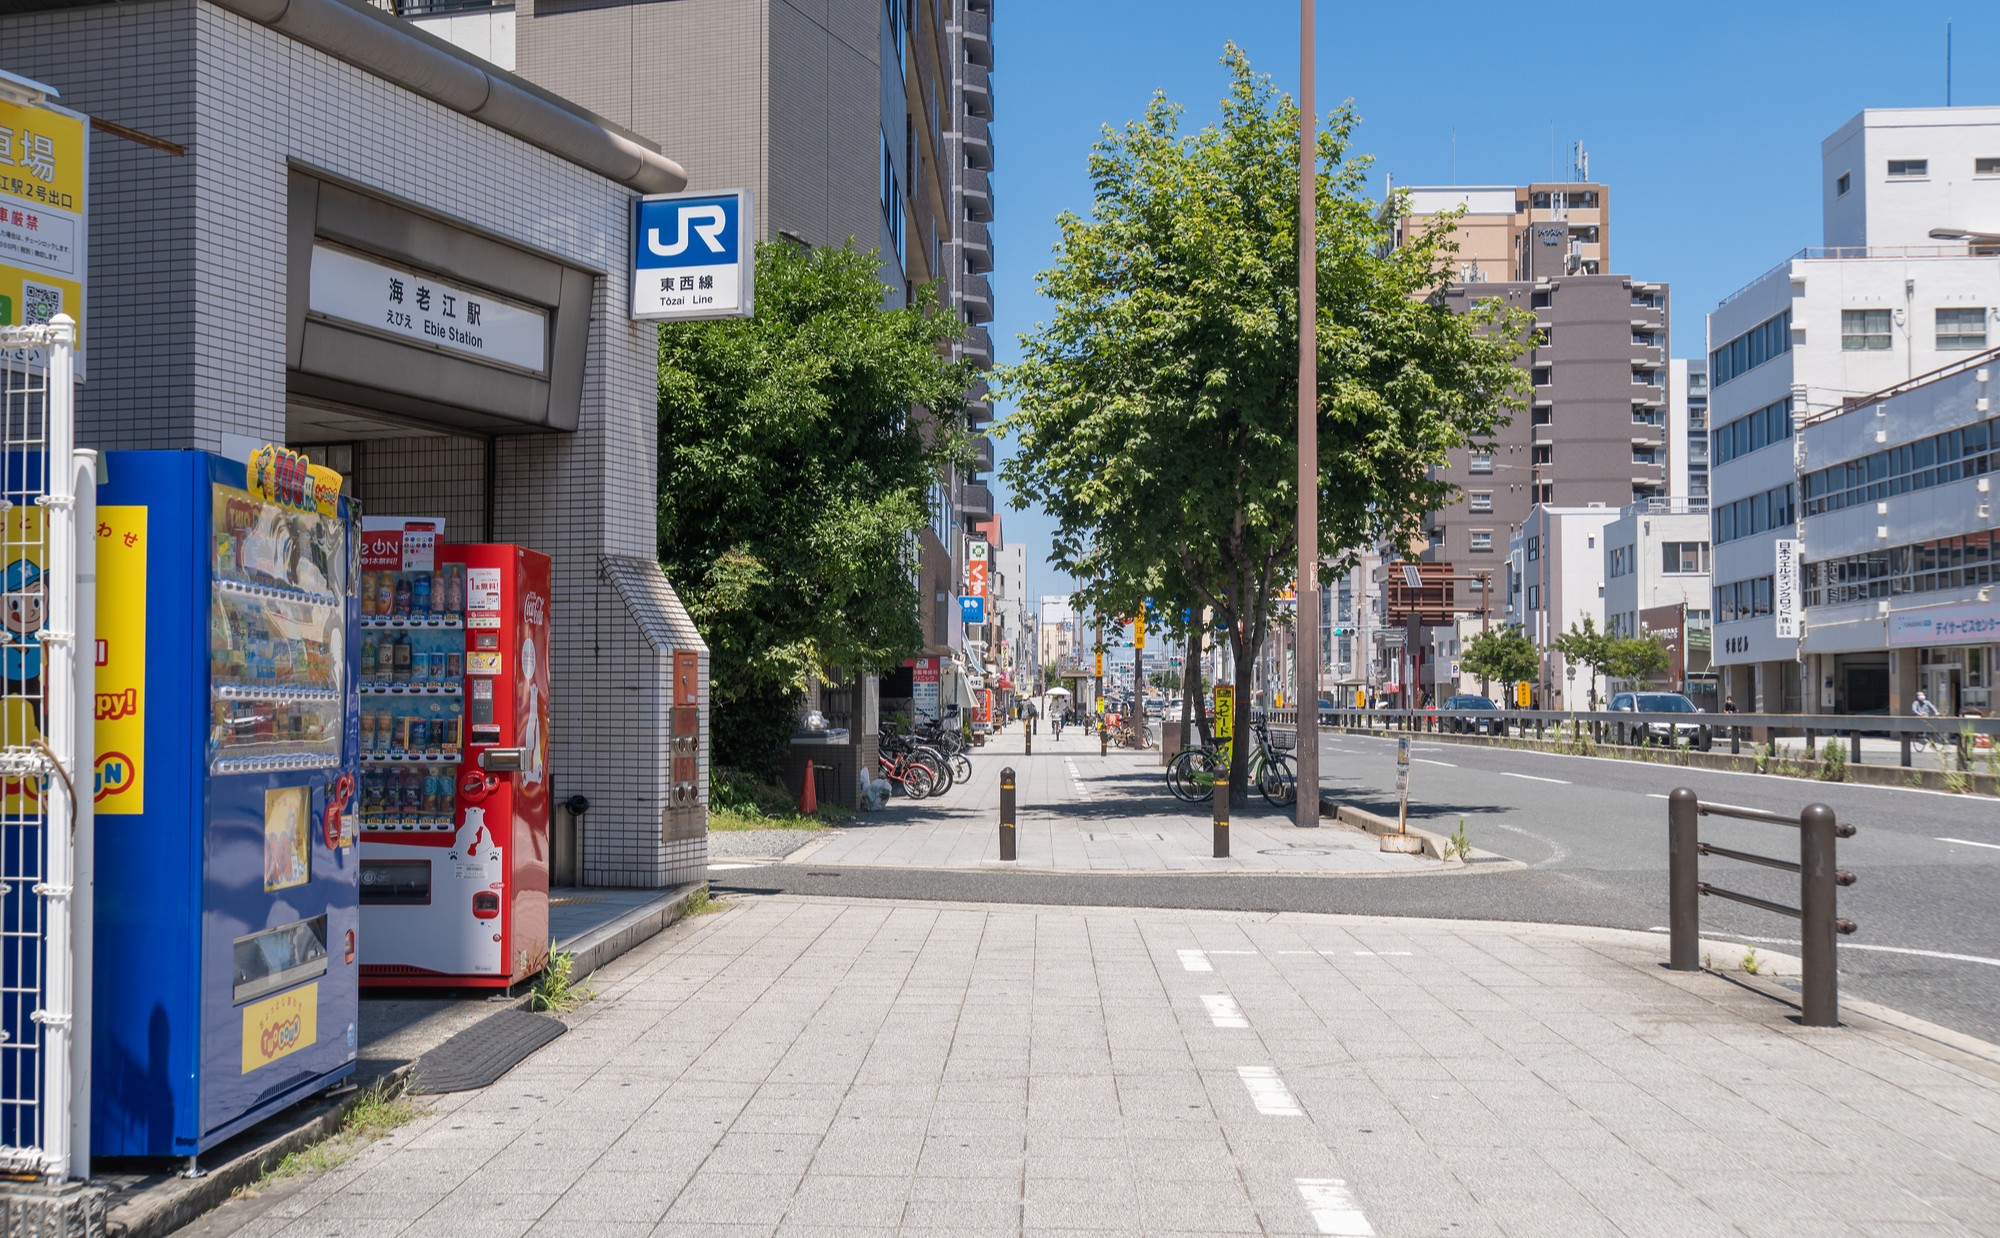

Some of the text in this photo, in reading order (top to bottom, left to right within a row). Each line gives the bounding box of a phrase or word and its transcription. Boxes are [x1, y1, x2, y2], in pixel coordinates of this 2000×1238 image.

[648, 205, 726, 256] JR
[660, 275, 713, 292] 東西線
[389, 277, 481, 327] 海老江駅
[692, 295, 713, 304] Line
[386, 309, 412, 329] えびえ
[424, 320, 483, 348] Ebie Station
[971, 564, 987, 597] くす
